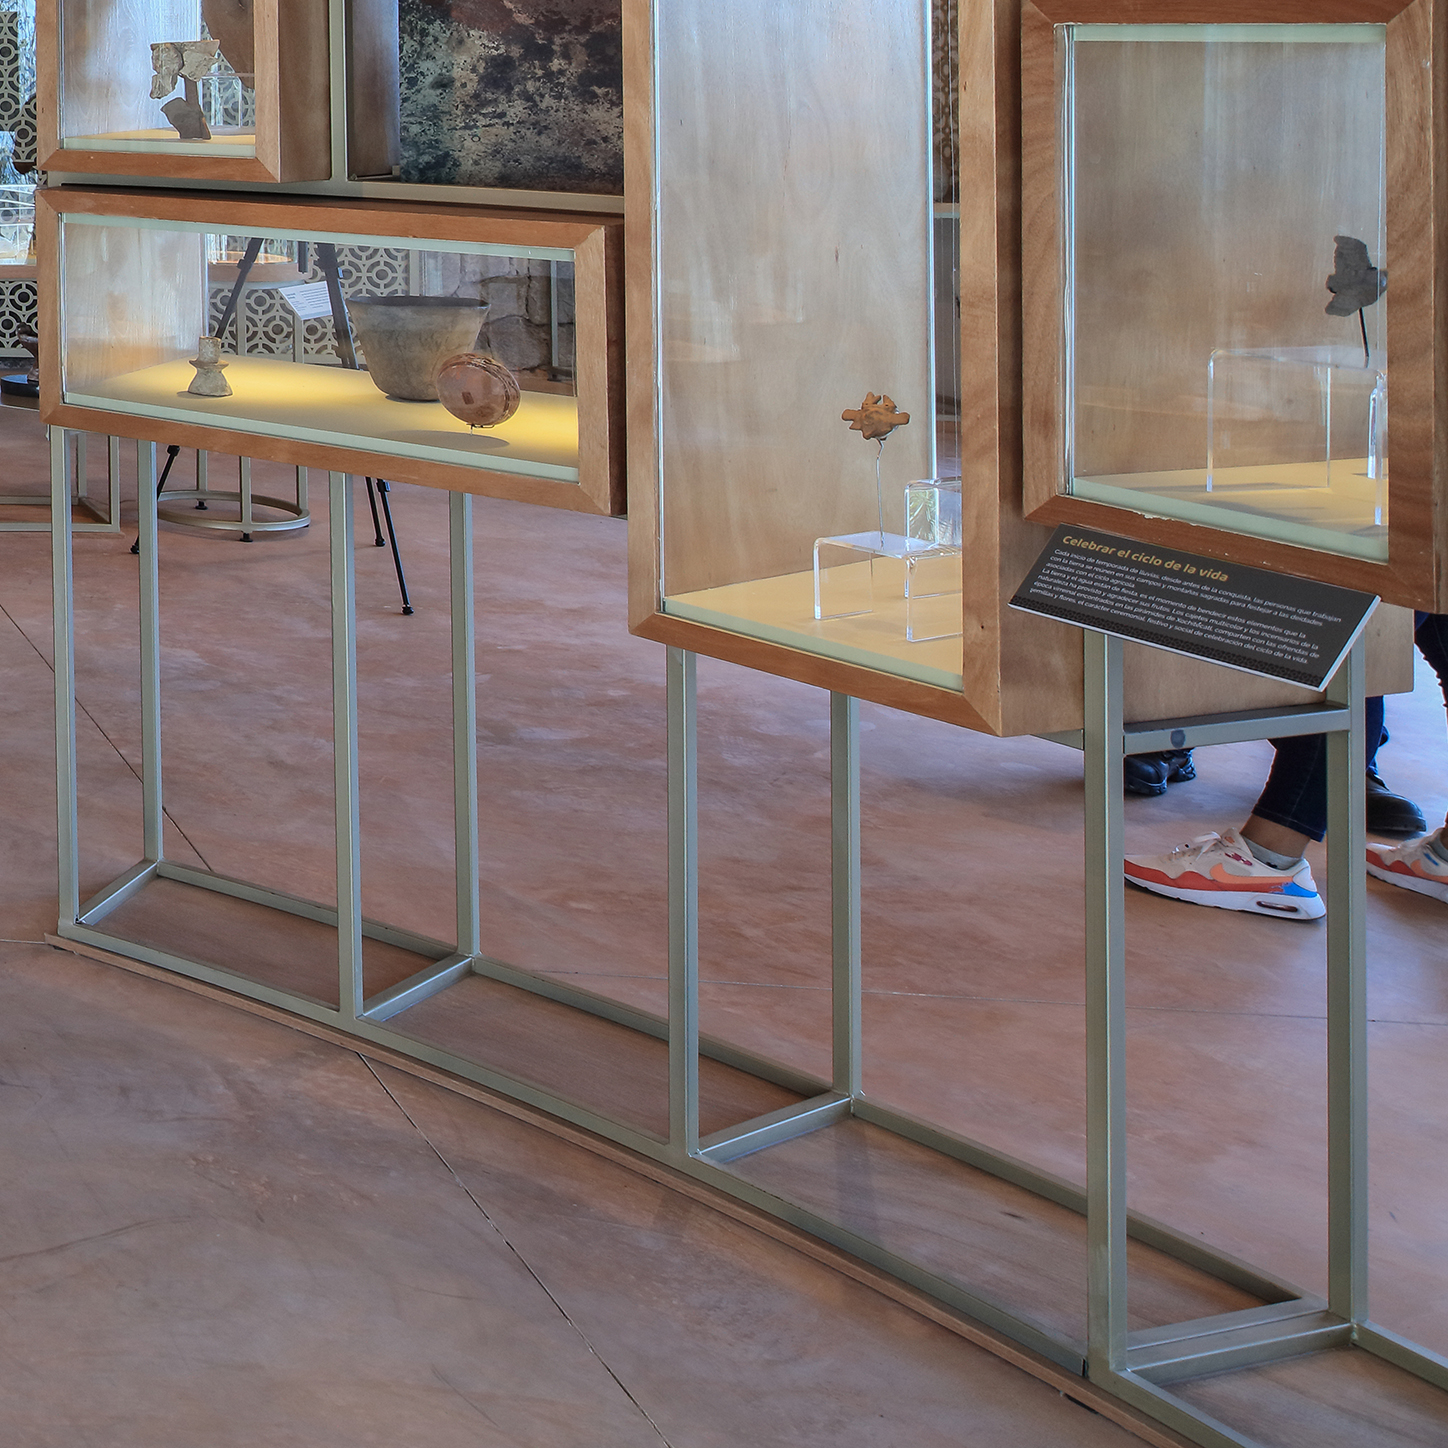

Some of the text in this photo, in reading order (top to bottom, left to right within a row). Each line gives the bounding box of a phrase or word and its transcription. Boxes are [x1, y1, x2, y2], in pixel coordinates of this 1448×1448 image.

[1062, 535, 1228, 582] Celebrar el ciclo de la vida
